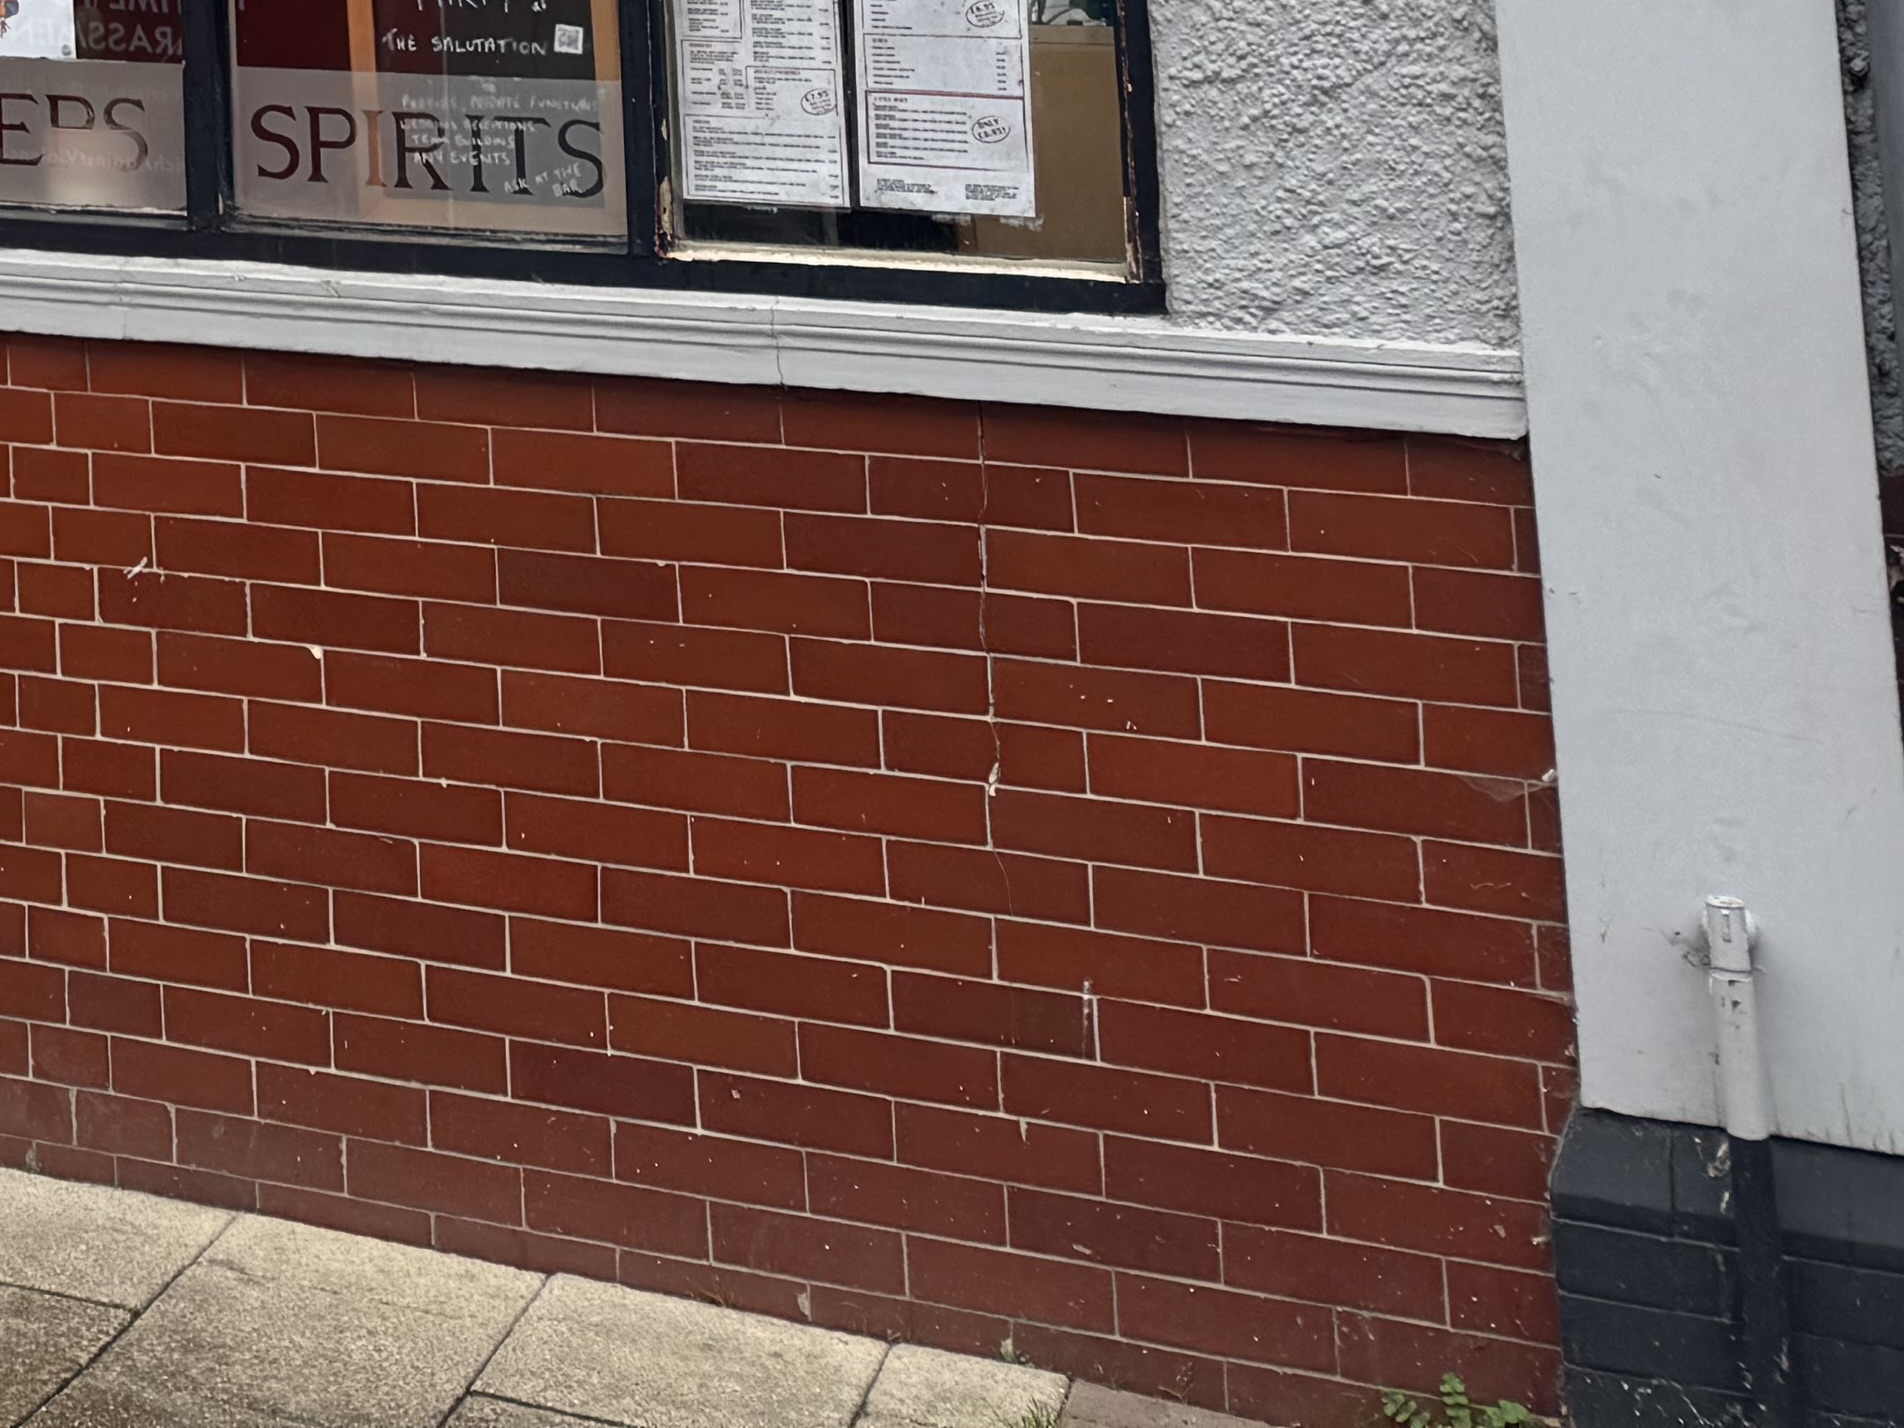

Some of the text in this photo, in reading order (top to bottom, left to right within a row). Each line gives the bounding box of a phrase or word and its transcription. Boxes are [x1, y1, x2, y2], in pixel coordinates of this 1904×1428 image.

[382, 28, 547, 56] THE SALUTATION
[250, 105, 604, 199] SPIRITS
[451, 151, 511, 166] EVENTS
[504, 178, 529, 193] ASK
[553, 163, 582, 178] THE
[552, 180, 582, 197] BAR
